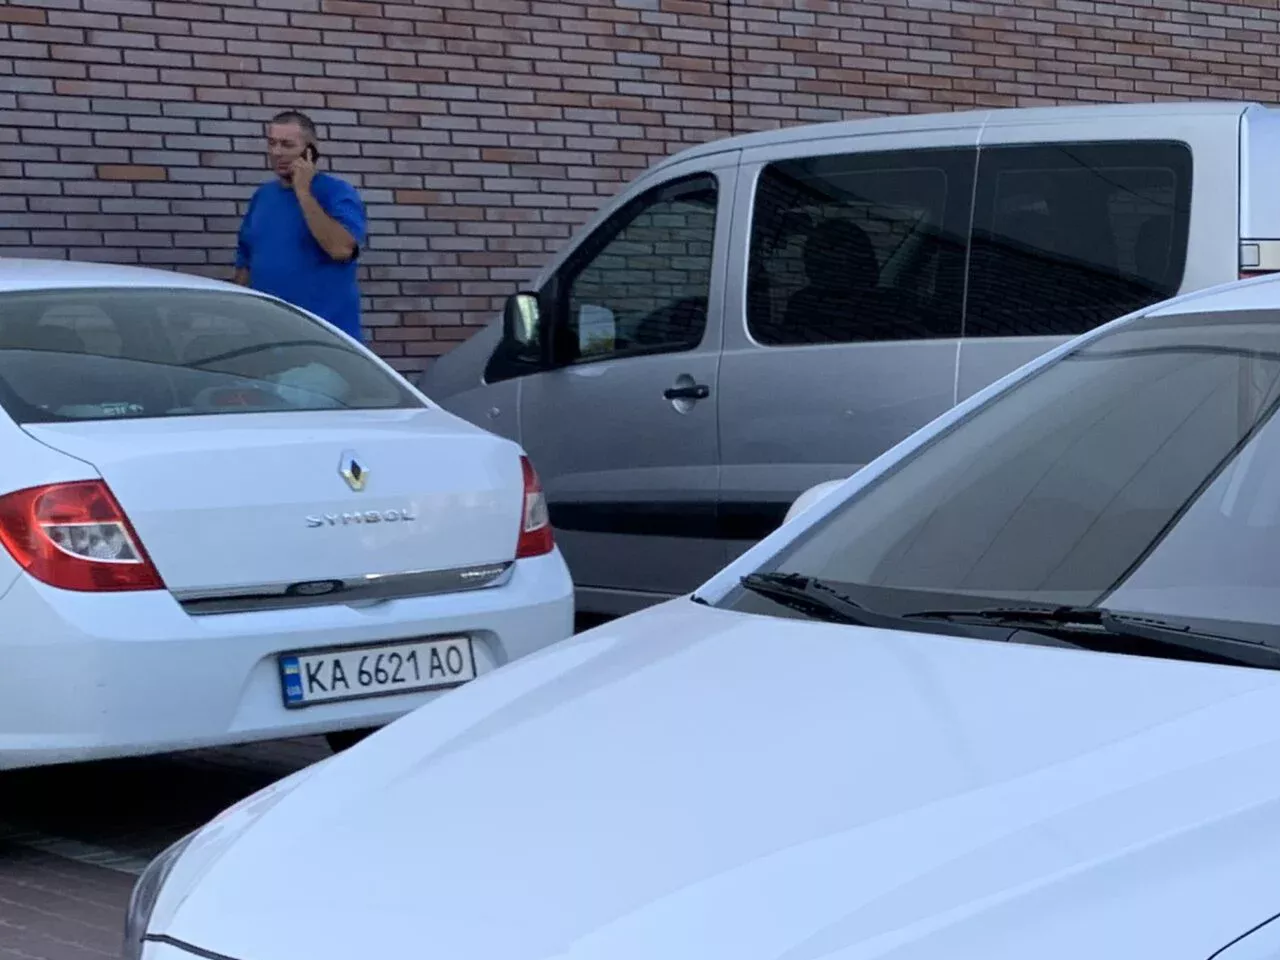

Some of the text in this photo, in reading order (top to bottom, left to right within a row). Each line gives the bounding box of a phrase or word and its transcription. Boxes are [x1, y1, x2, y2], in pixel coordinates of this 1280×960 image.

[306, 509, 415, 528] SYMBOL
[306, 646, 463, 693] KA 6621 AO
